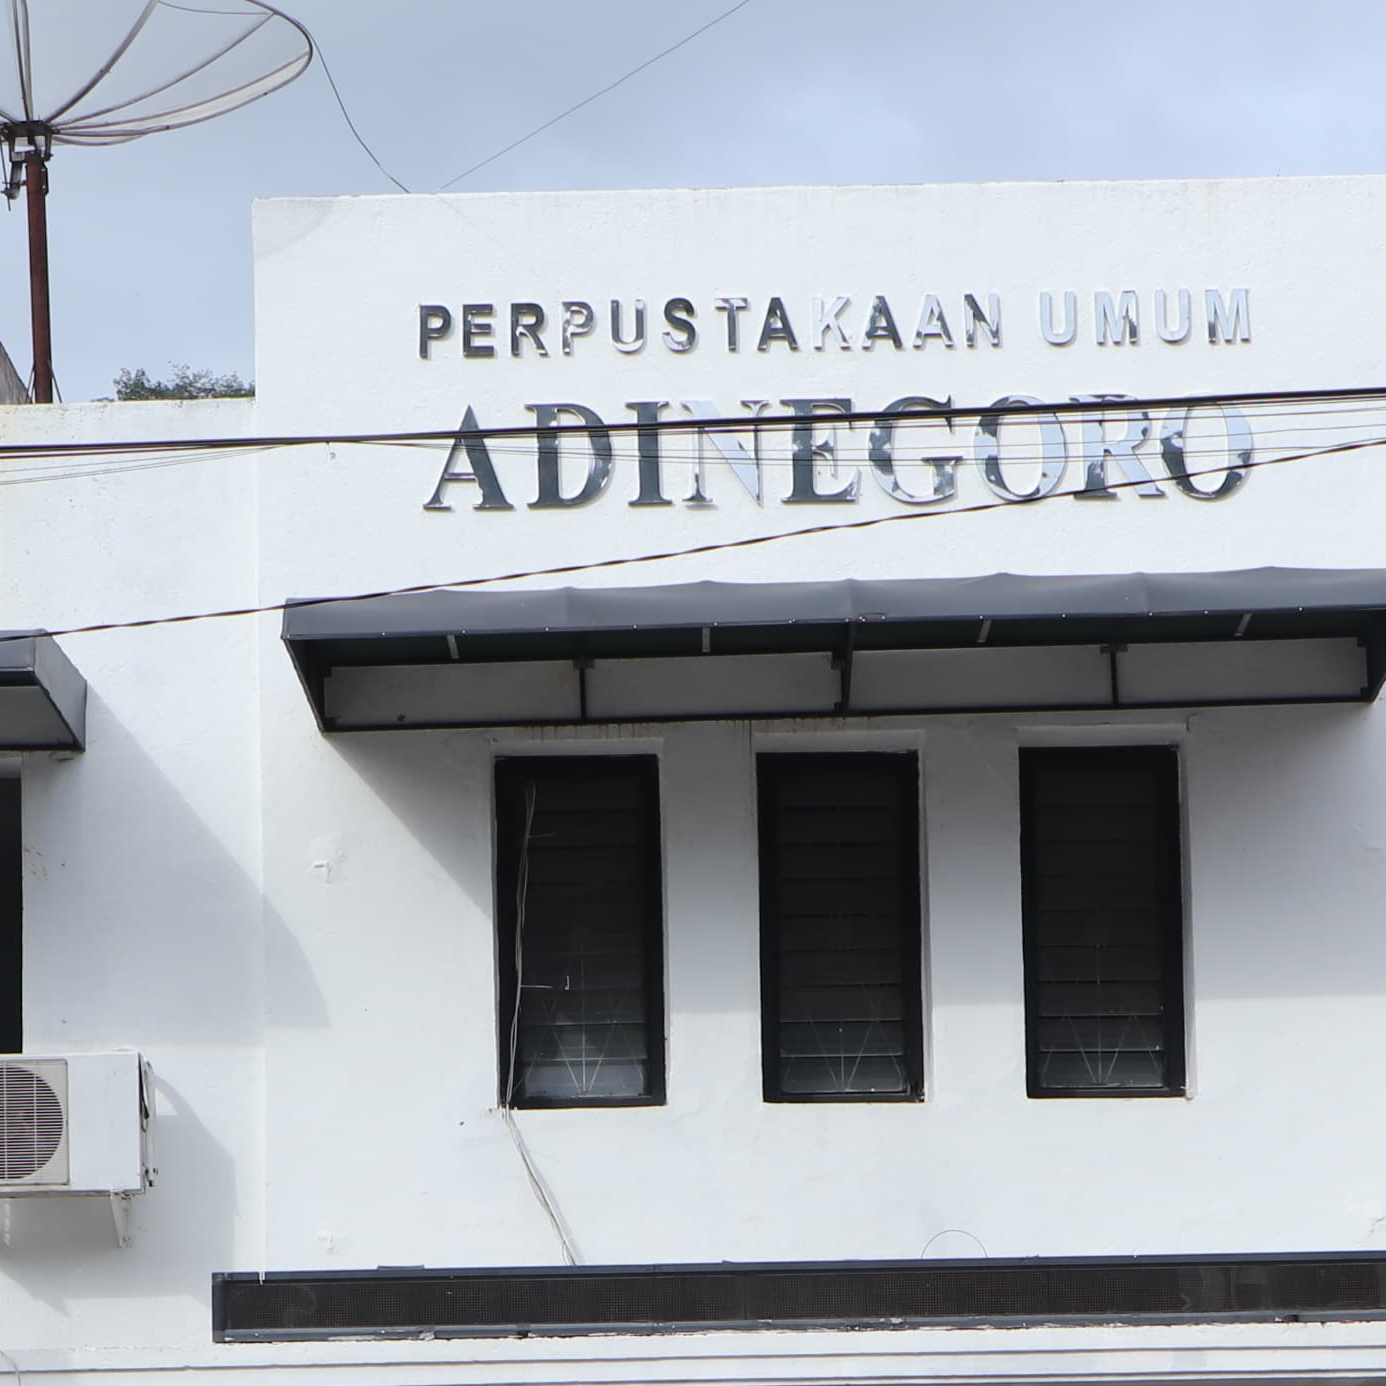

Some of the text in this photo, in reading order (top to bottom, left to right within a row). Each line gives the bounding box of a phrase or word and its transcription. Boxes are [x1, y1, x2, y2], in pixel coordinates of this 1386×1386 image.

[418, 287, 1252, 360] PERPUSTAKAAN UMUM
[424, 391, 1254, 511] ADINEGORO
